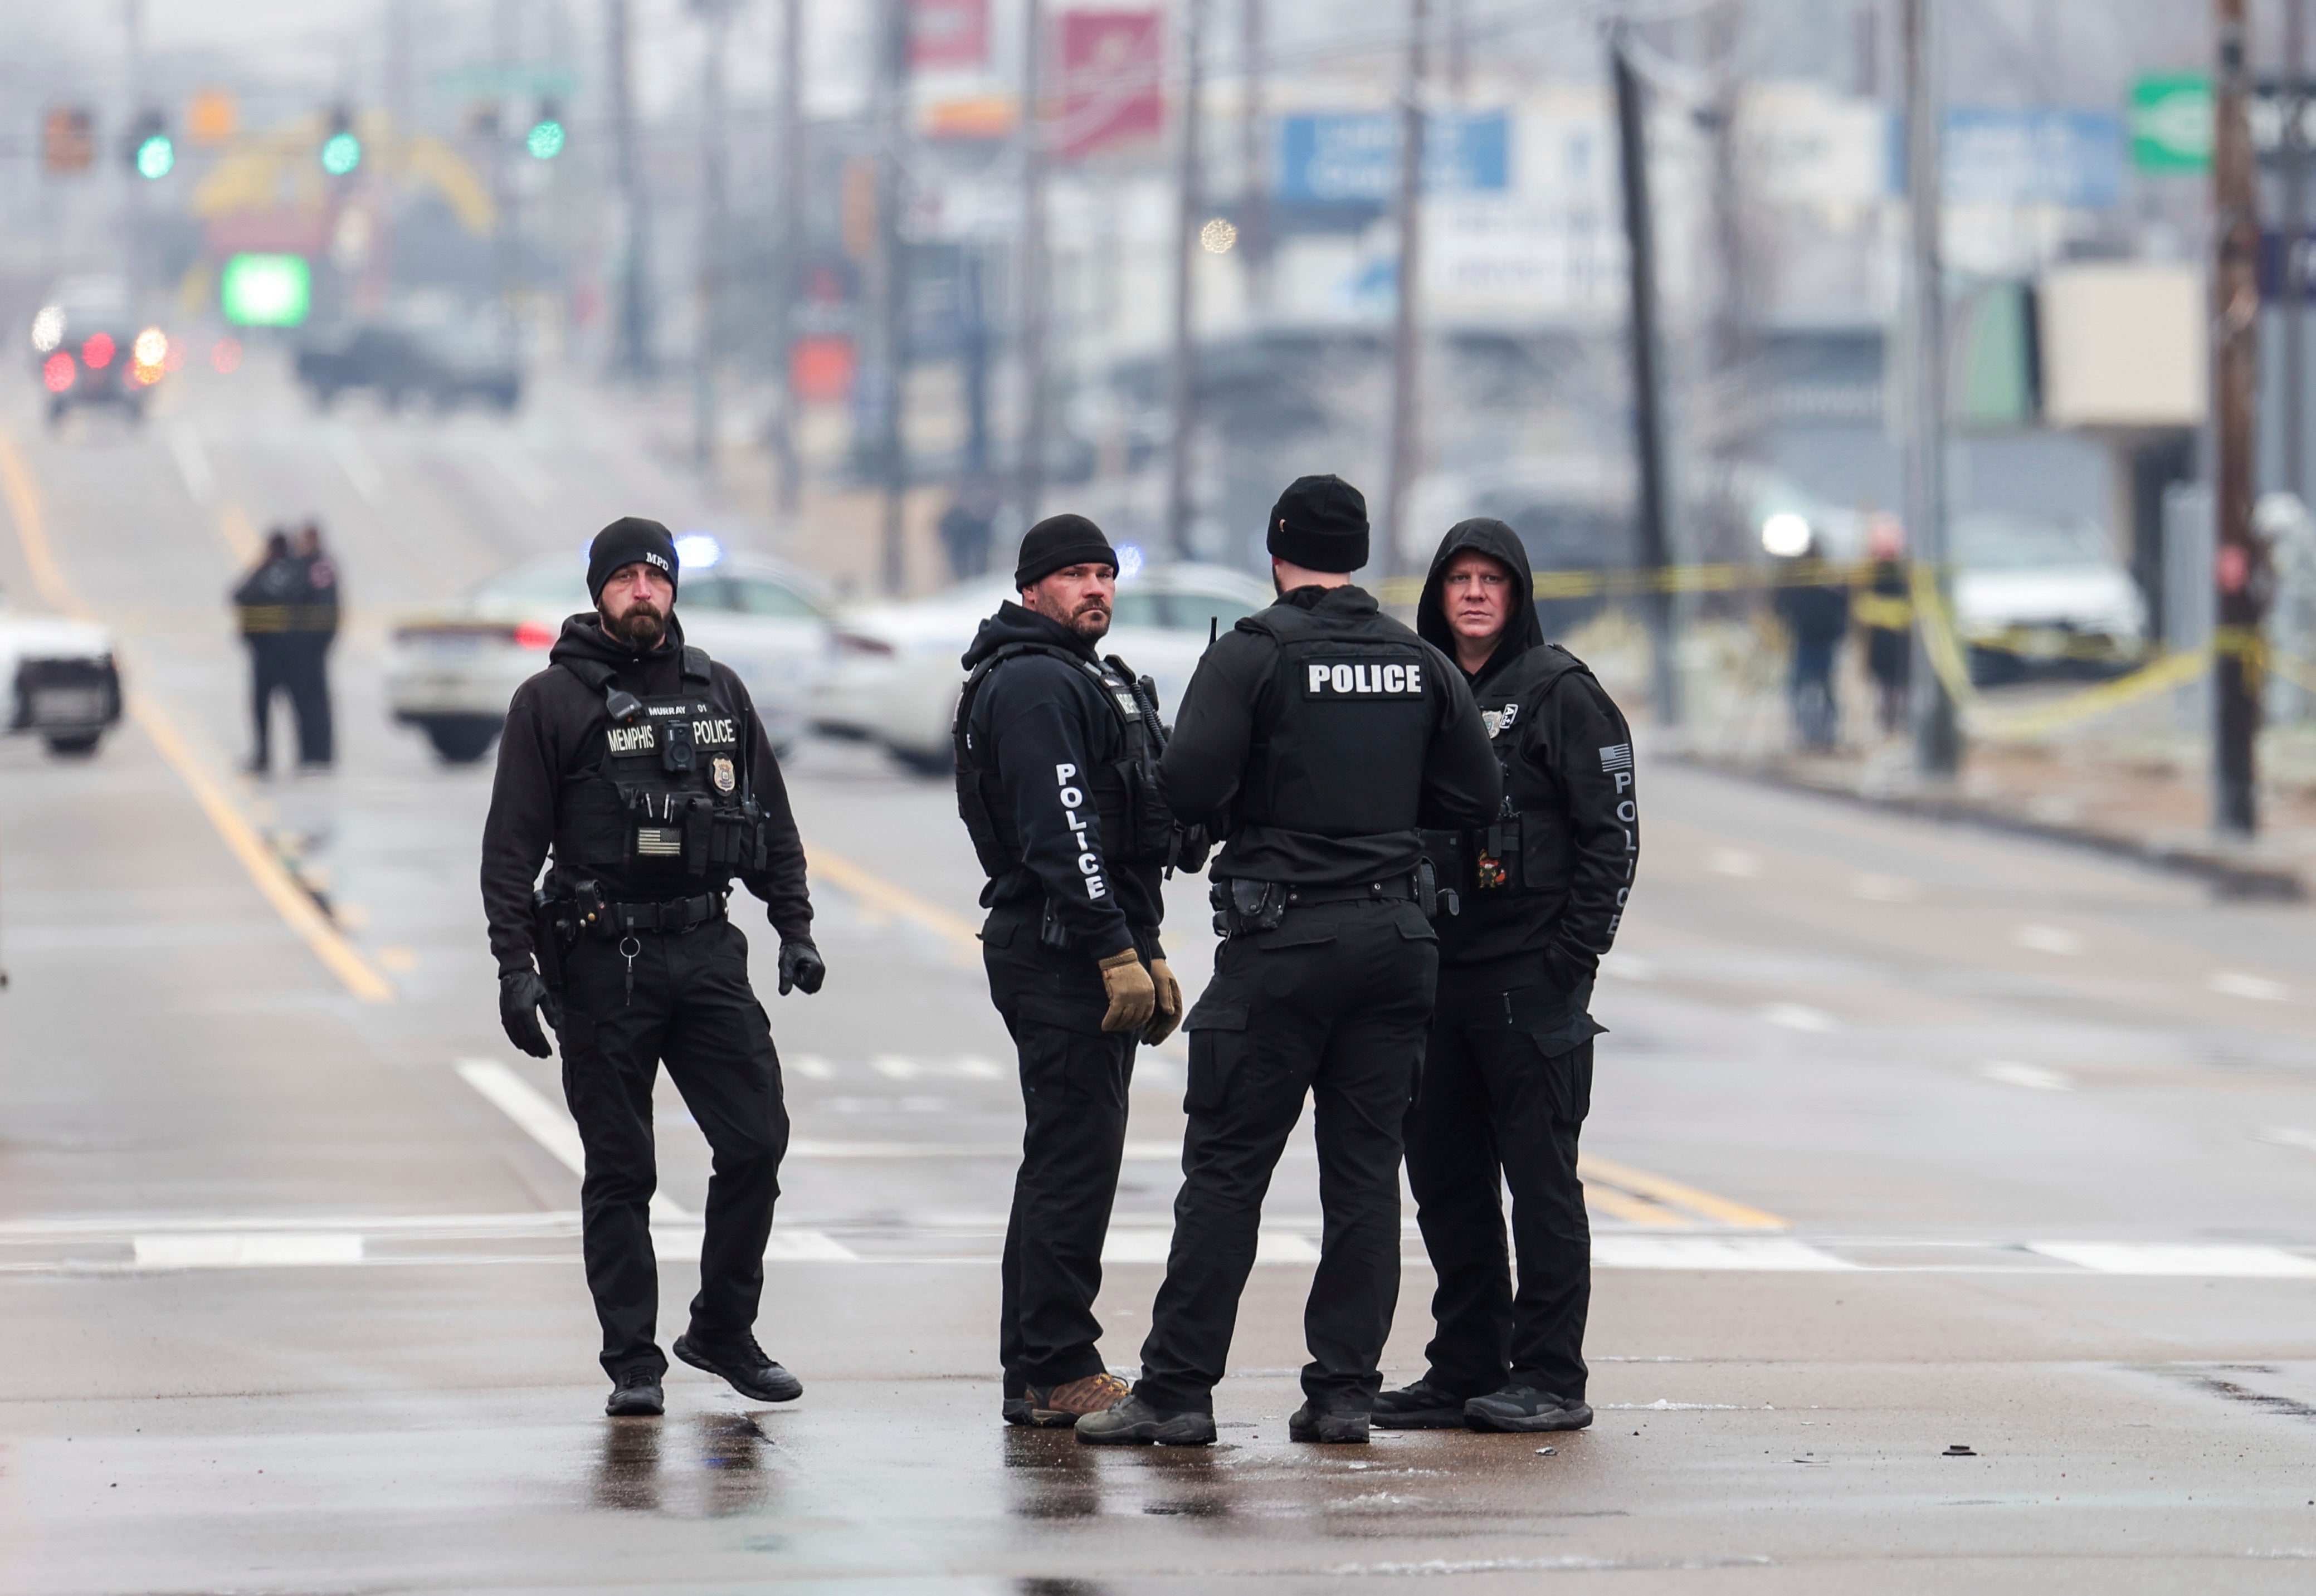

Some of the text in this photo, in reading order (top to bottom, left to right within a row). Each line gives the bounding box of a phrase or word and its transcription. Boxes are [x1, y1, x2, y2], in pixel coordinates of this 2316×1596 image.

[646, 552, 669, 571] MPD
[1309, 665, 1421, 692] POLICE
[648, 706, 686, 716] MURRAY
[607, 719, 735, 752] MEMPHIS POLICE
[1056, 763, 1105, 900] POLICE
